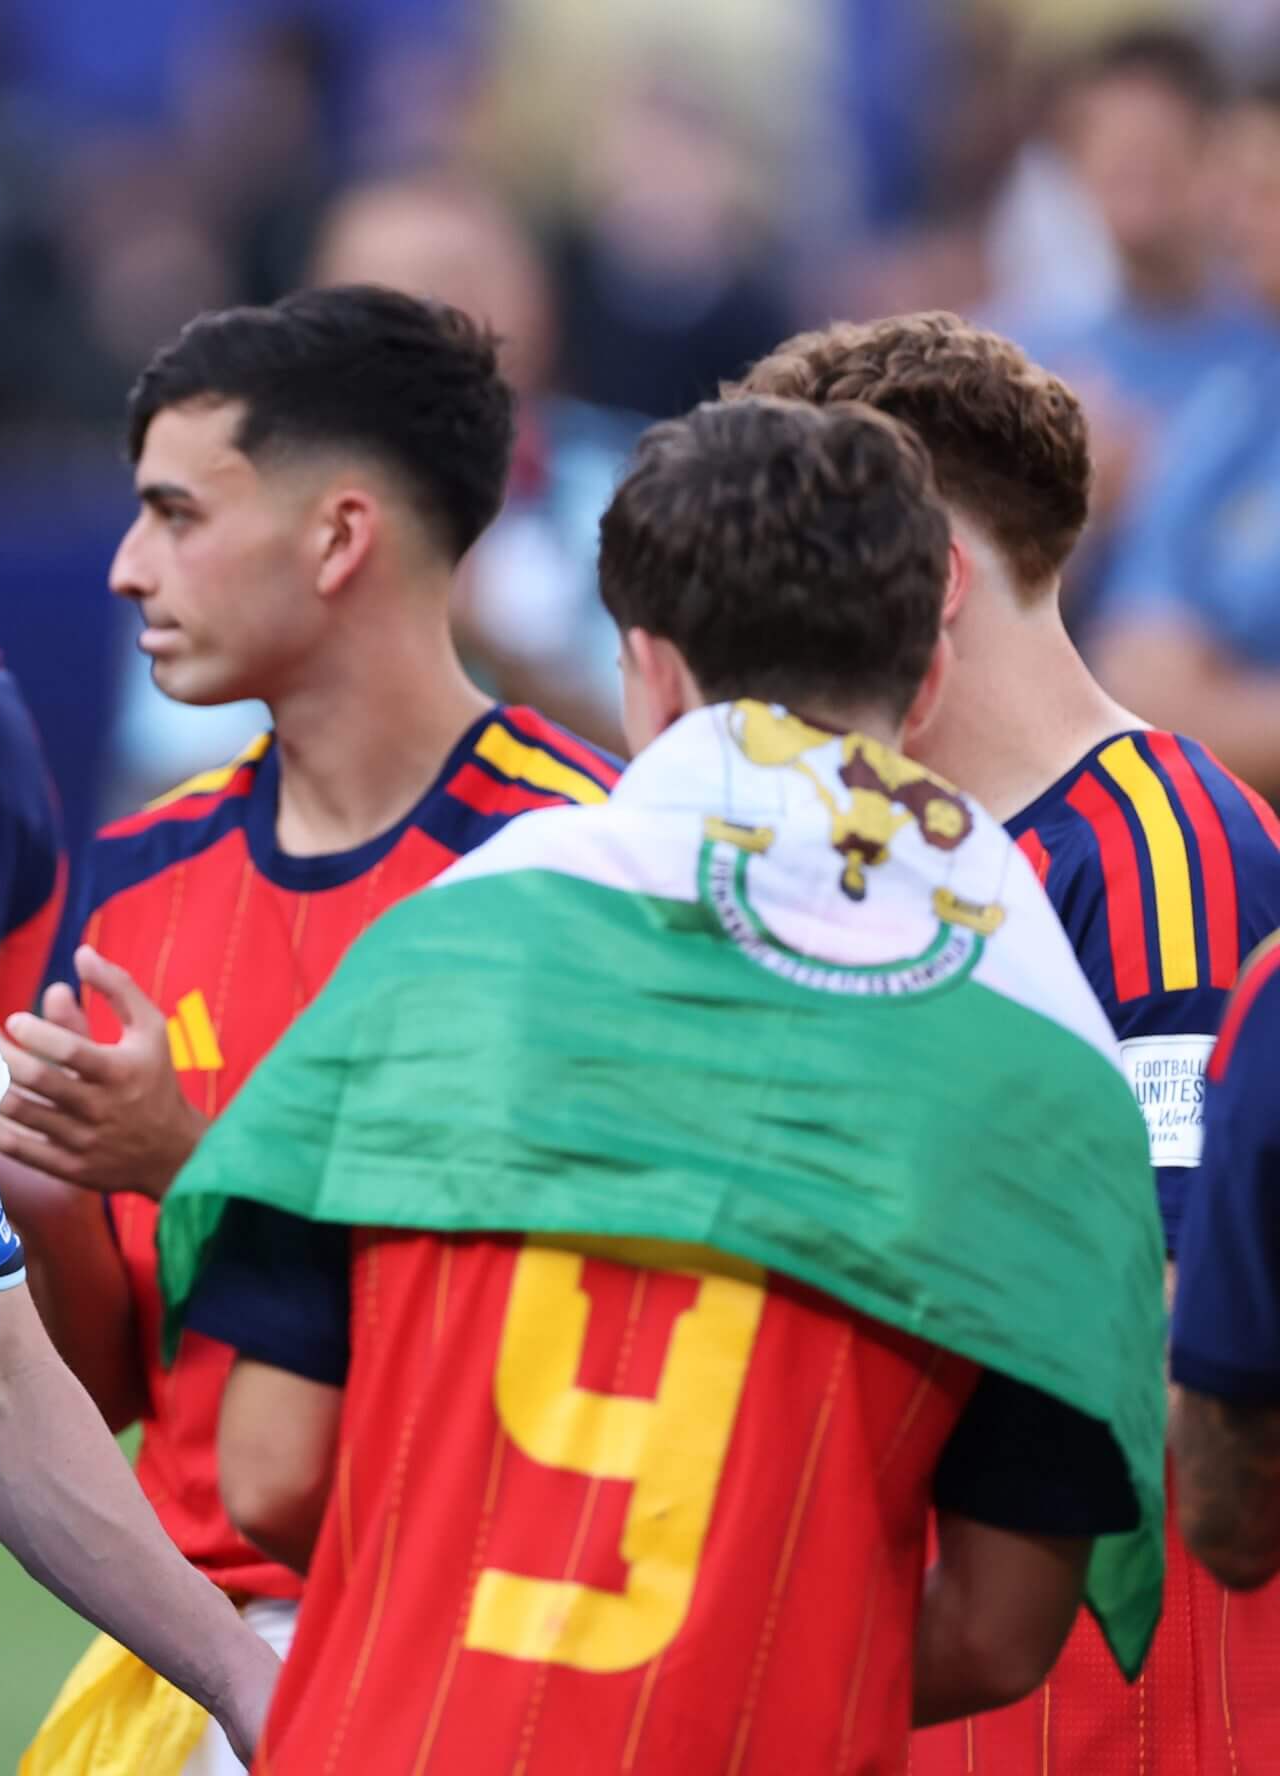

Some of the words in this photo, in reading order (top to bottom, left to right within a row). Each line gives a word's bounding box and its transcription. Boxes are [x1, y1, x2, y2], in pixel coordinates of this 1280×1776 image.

[1135, 1059, 1205, 1078] FOOTBALL
[1135, 1079, 1204, 1105] UNITES
[465, 1232, 766, 1673] 9
